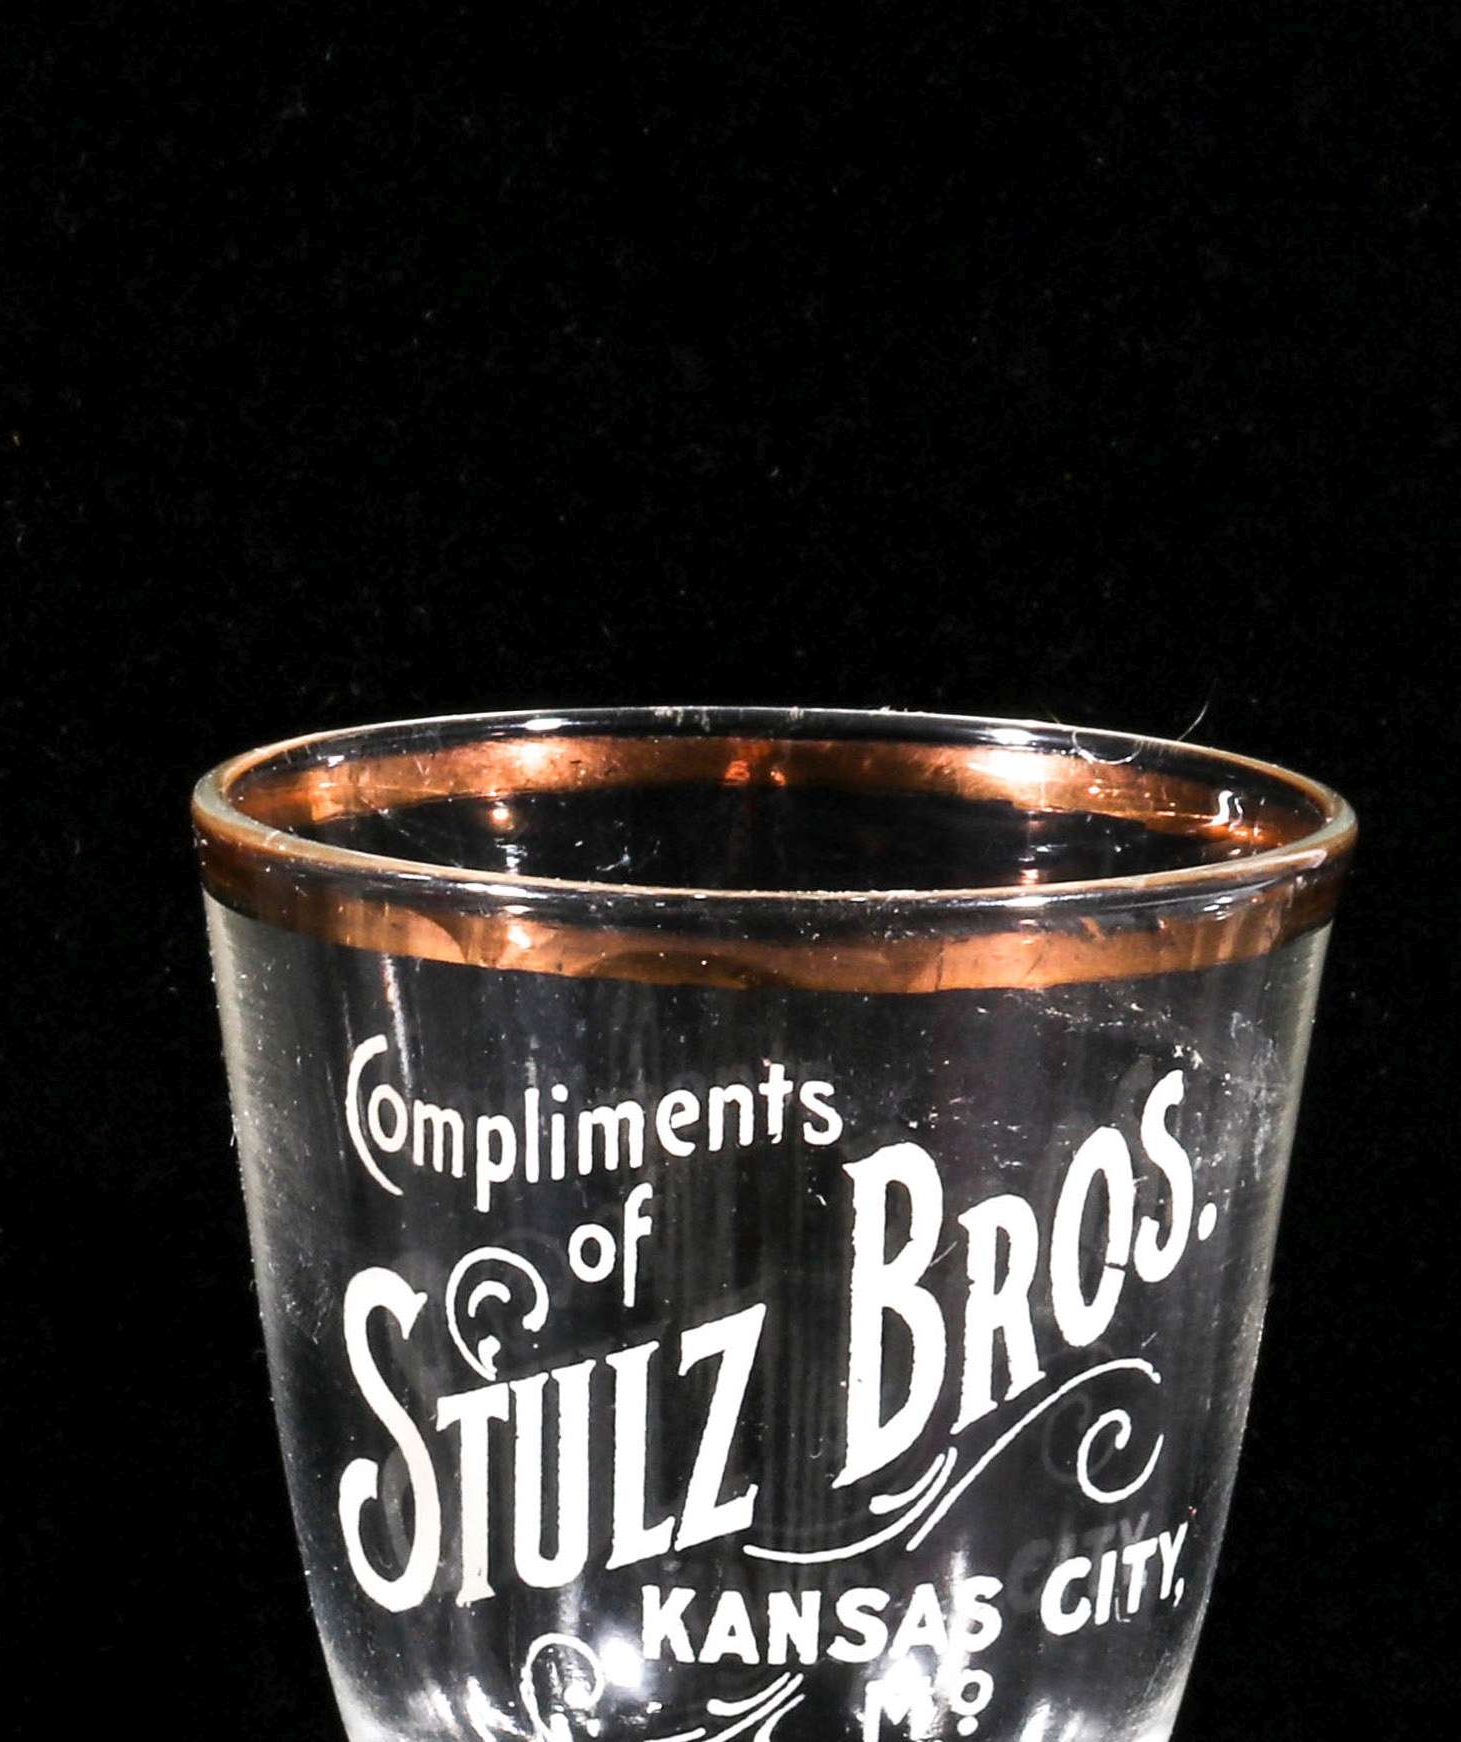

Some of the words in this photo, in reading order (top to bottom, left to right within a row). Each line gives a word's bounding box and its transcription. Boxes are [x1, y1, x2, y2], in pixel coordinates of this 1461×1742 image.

[344, 1034, 843, 1213] Compliments
[568, 1184, 653, 1307] of
[338, 1267, 768, 1613] STULZ
[833, 1069, 1219, 1490] BROS.
[641, 1574, 1004, 1665] KANSAS
